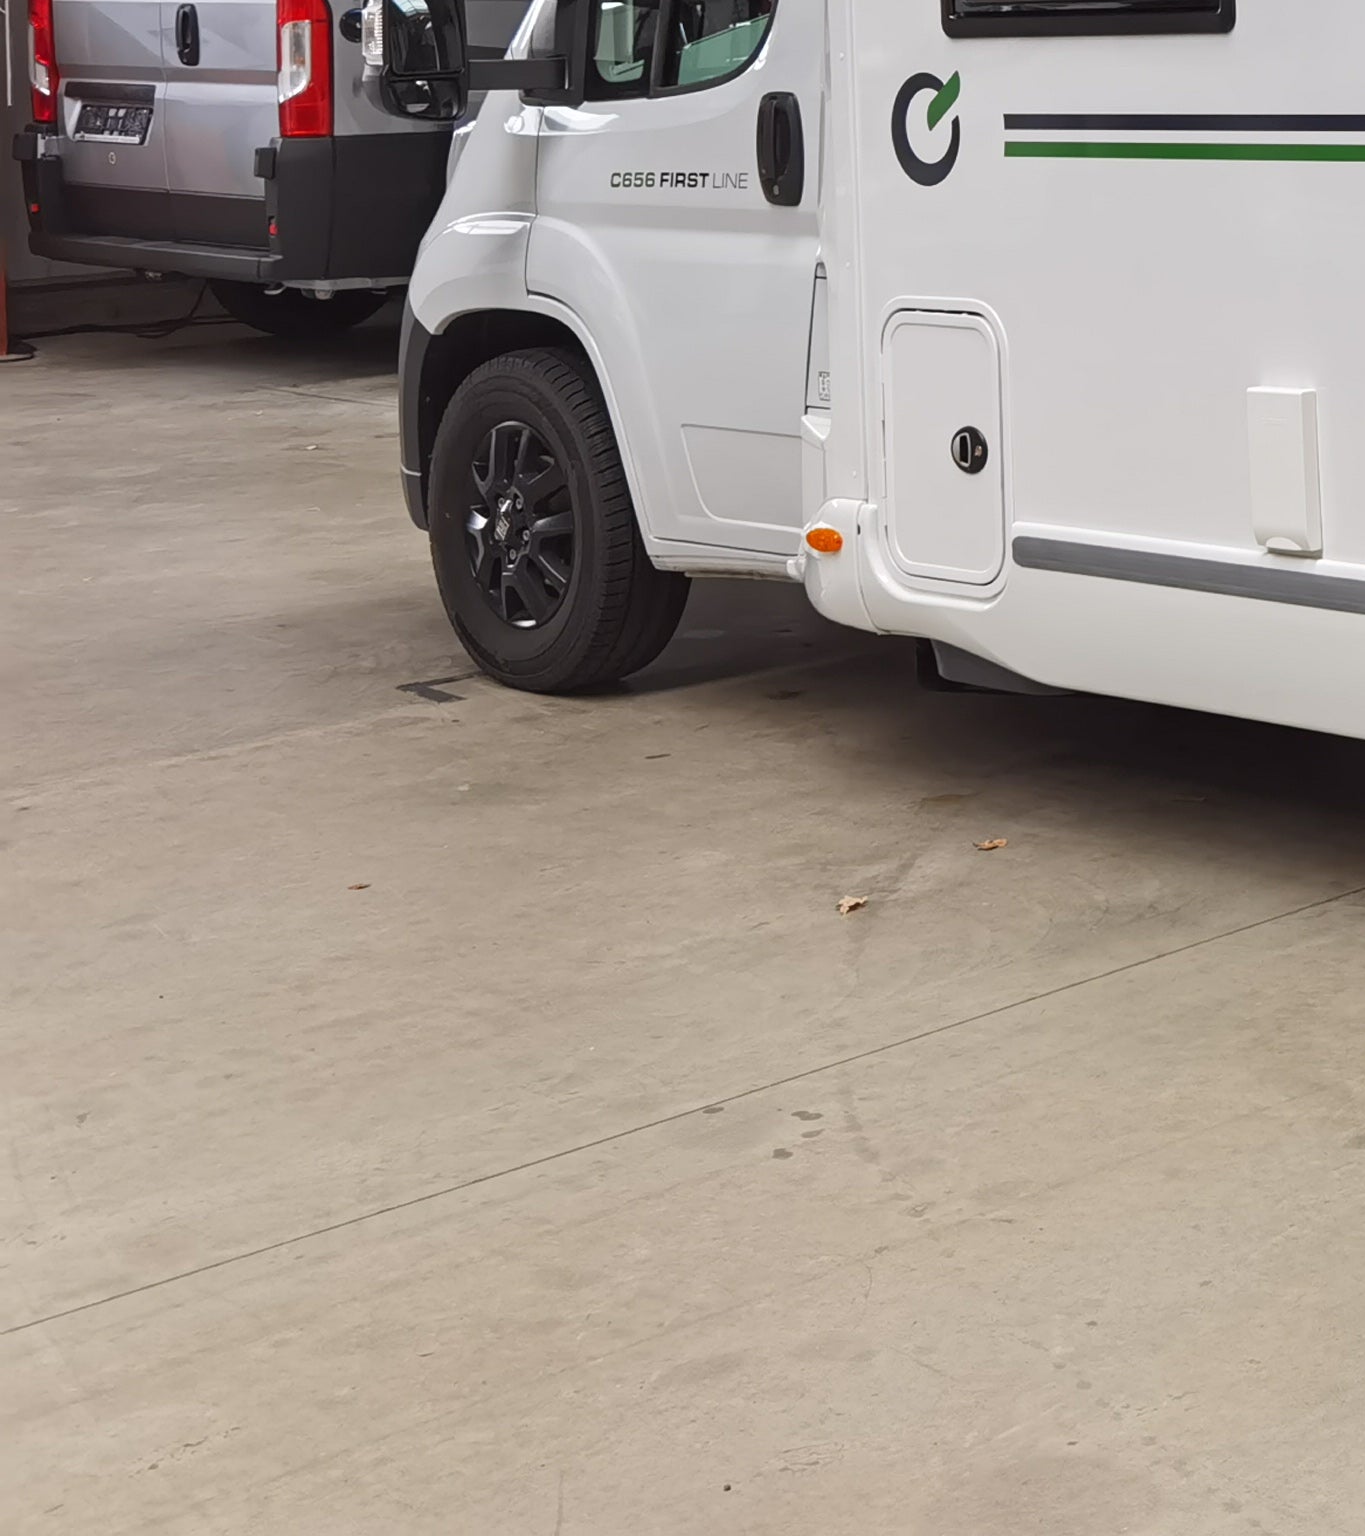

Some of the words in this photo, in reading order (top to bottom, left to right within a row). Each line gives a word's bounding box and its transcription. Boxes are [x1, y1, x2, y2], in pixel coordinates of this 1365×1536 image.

[610, 172, 656, 188] C656
[660, 172, 710, 188] FIRST
[712, 172, 749, 189] LINE
